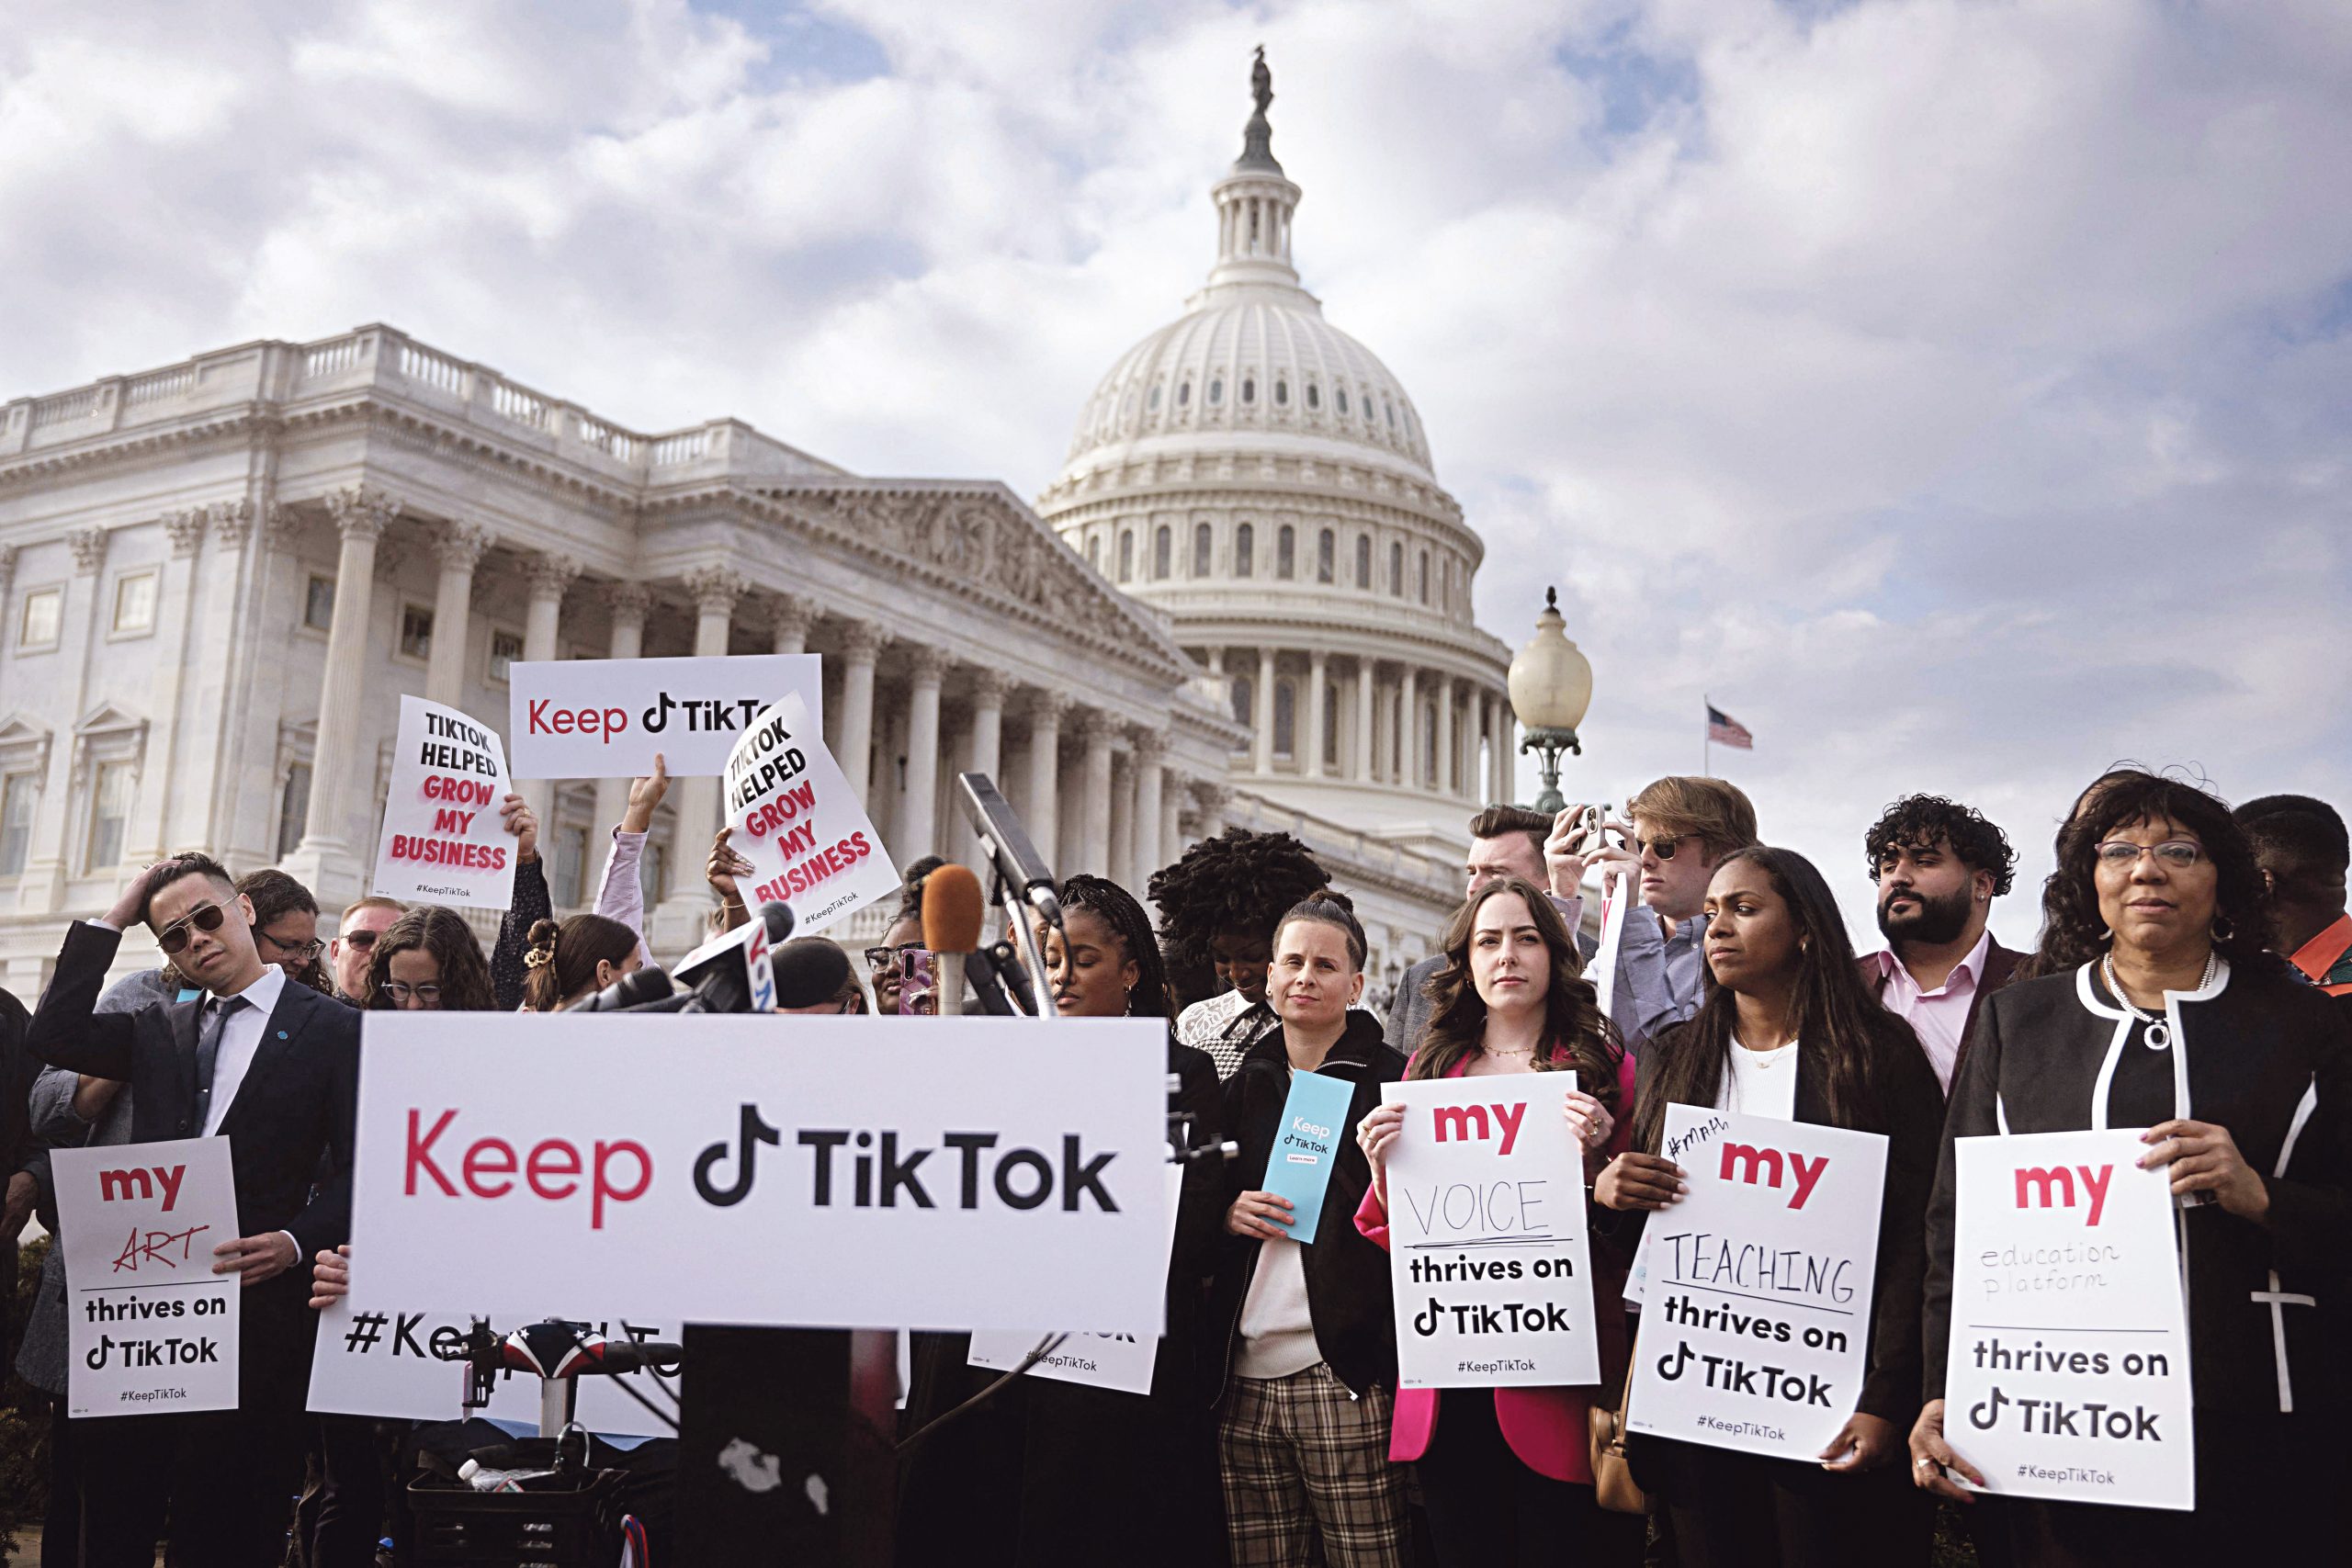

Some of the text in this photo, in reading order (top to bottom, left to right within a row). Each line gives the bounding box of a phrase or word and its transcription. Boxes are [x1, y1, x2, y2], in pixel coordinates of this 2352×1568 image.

[425, 712, 492, 753] TIKTOK
[528, 698, 774, 744] Keep TikT
[421, 741, 498, 777] HELPED
[730, 716, 792, 783] TIKTOK
[424, 774, 495, 806] GROW
[731, 747, 807, 814] HELPED
[434, 808, 476, 835] MY
[746, 779, 817, 837] GROW
[391, 834, 507, 870] BUSINESS
[777, 818, 817, 862] MY
[755, 830, 871, 905] BUSINESS
[416, 884, 471, 897] #KeepTikTok
[805, 892, 859, 925] #KeepTikTok
[1293, 1116, 1330, 1140] Keep
[1295, 1137, 1329, 1155] TikTok
[1433, 1102, 1528, 1156] my
[404, 1107, 1122, 1231] Keep TikTok
[1720, 1142, 1830, 1211] my
[100, 1165, 187, 1212] my
[1405, 1180, 1548, 1235] VOICE
[2015, 1164, 2114, 1227] my
[112, 1224, 210, 1273] ART
[1980, 1242, 2120, 1267] education
[1410, 1255, 1574, 1283] thrives on
[1663, 1233, 1854, 1303] TEACHING
[1983, 1269, 2108, 1302] platform
[85, 1295, 226, 1323] thrives on
[1451, 1302, 1571, 1335] TikTok
[1664, 1295, 1848, 1353] thrives on
[119, 1337, 219, 1369] TikTok
[1458, 1358, 1537, 1376] #KeepTikTok
[1974, 1339, 2169, 1377] thrives on
[120, 1387, 187, 1403] #KeepTikTok
[1702, 1355, 1833, 1409] TikTok
[1697, 1415, 1786, 1441] #KeepTikTok
[2017, 1399, 2163, 1442] TikTok
[2018, 1464, 2116, 1486] #KeepTikTok
